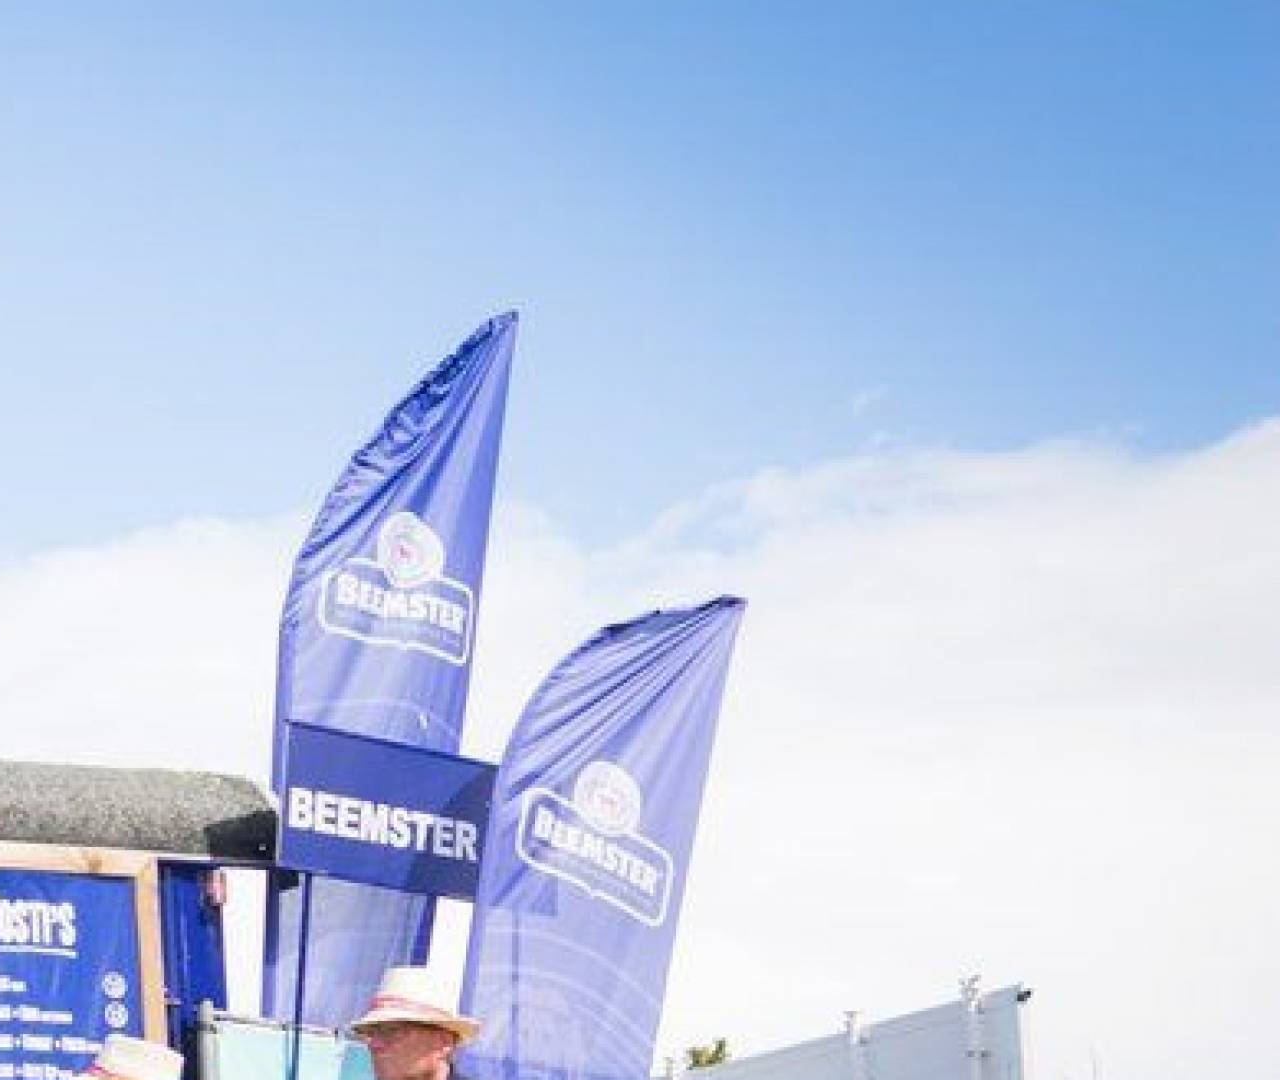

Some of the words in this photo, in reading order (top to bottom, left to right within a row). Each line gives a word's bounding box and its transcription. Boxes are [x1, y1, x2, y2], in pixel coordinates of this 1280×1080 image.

[337, 573, 466, 634] BEEMSTER
[288, 788, 478, 861] BEEMSTER
[533, 805, 658, 896] BEEMSTER
